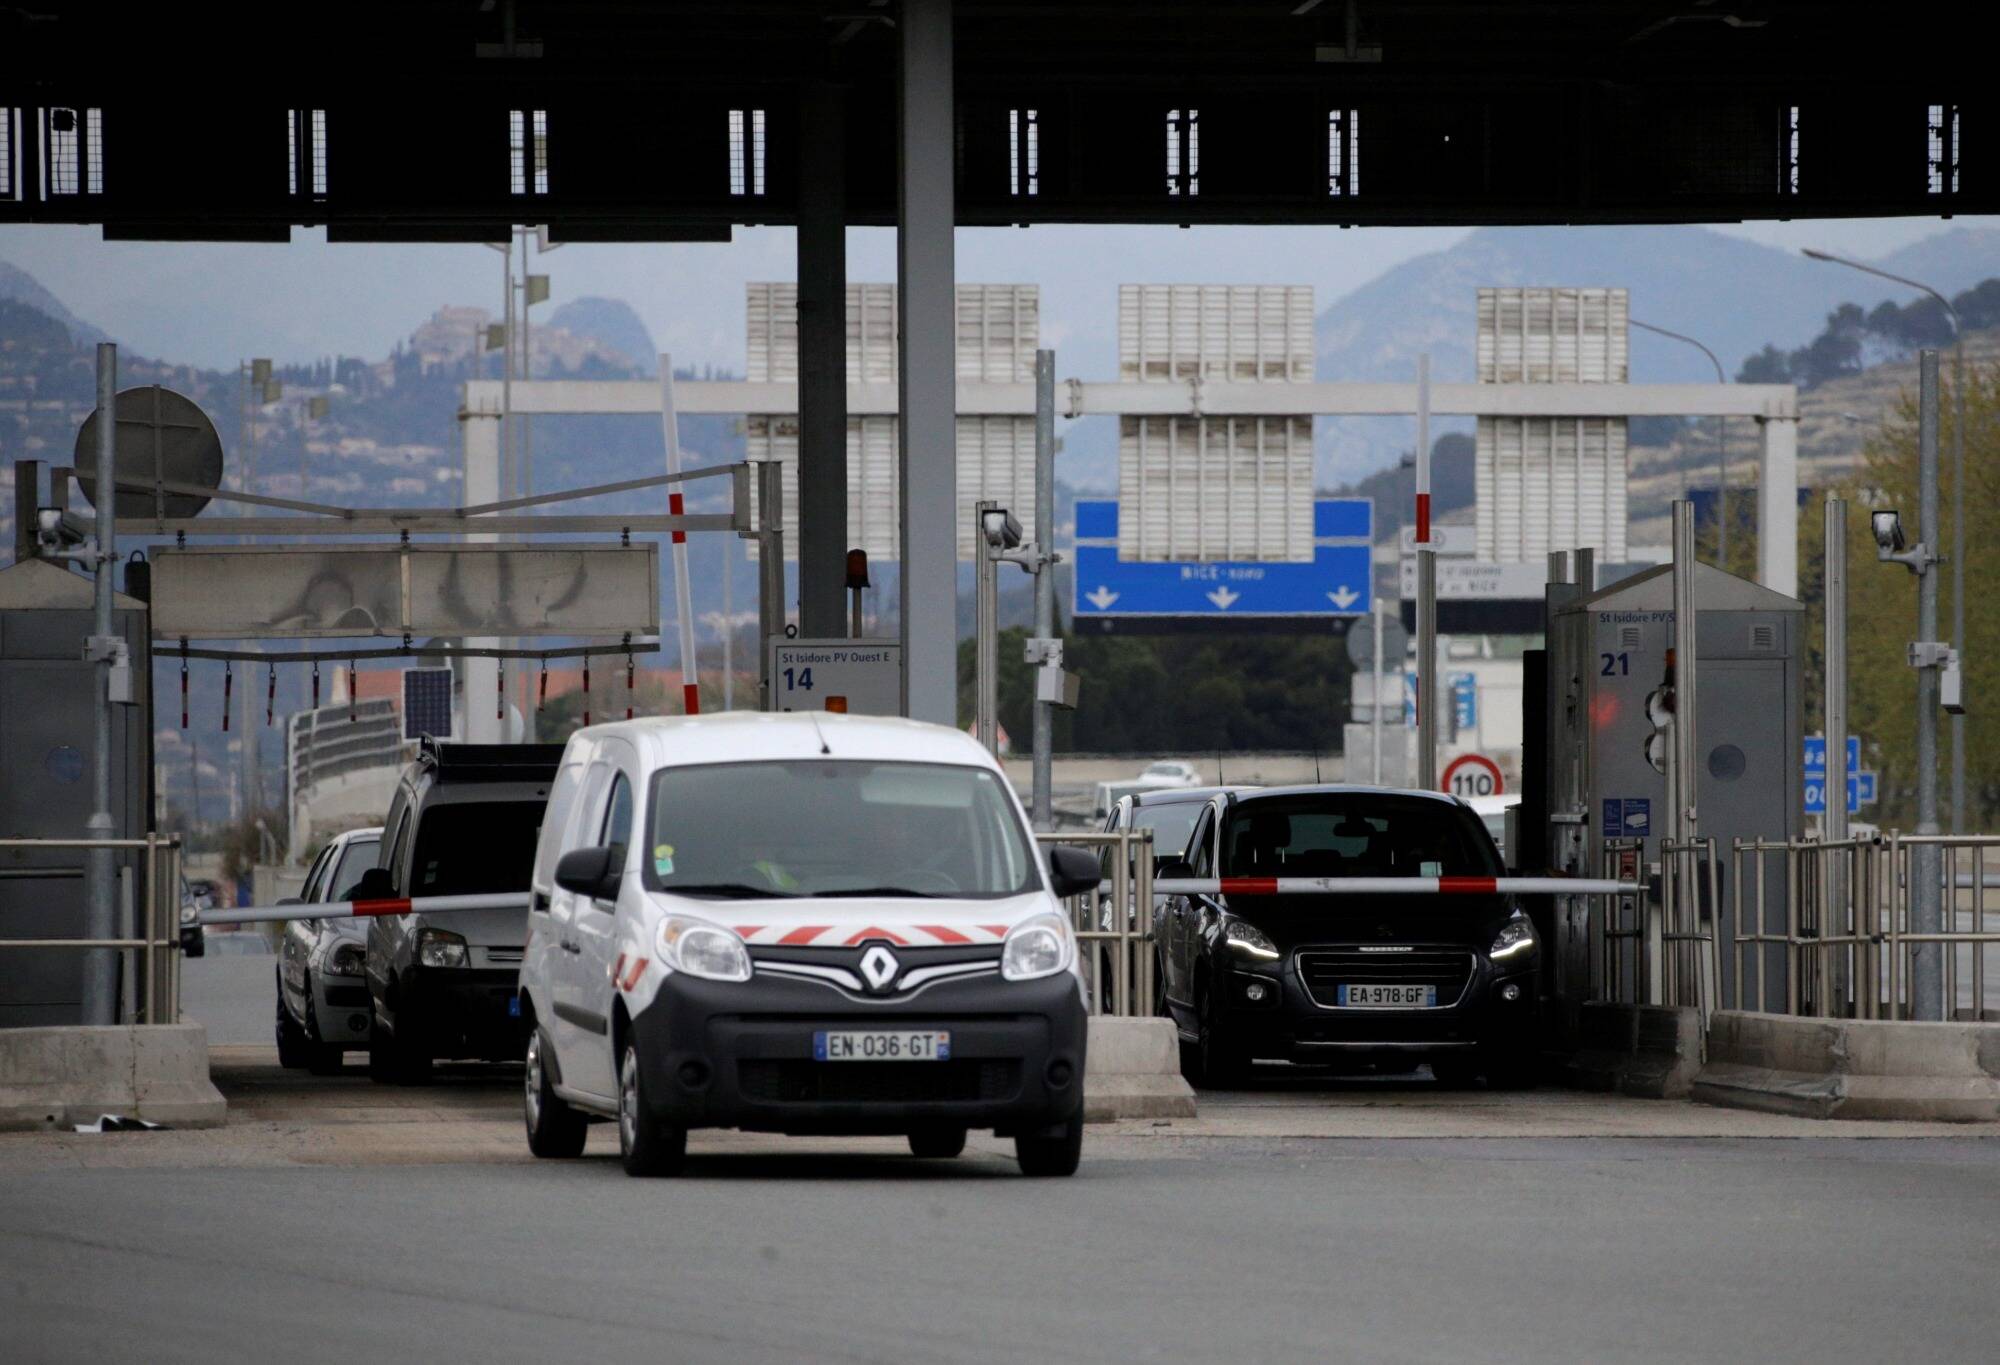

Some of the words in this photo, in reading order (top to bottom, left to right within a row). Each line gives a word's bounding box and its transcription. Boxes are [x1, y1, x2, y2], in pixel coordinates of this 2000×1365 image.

[1600, 613, 1610, 623] St
[1615, 612, 1648, 623] Isidore
[1652, 613, 1665, 623] PV
[783, 653, 793, 663] St
[797, 653, 831, 663] Isidore
[834, 652, 848, 662] PV
[850, 652, 880, 662] Ouest
[884, 652, 890, 661] E
[1601, 653, 1629, 676] 21
[783, 667, 813, 690] 14
[1454, 774, 1492, 796] 110
[1350, 988, 1423, 1003] EA-978-GF
[830, 1036, 933, 1056] EN-036-GT
